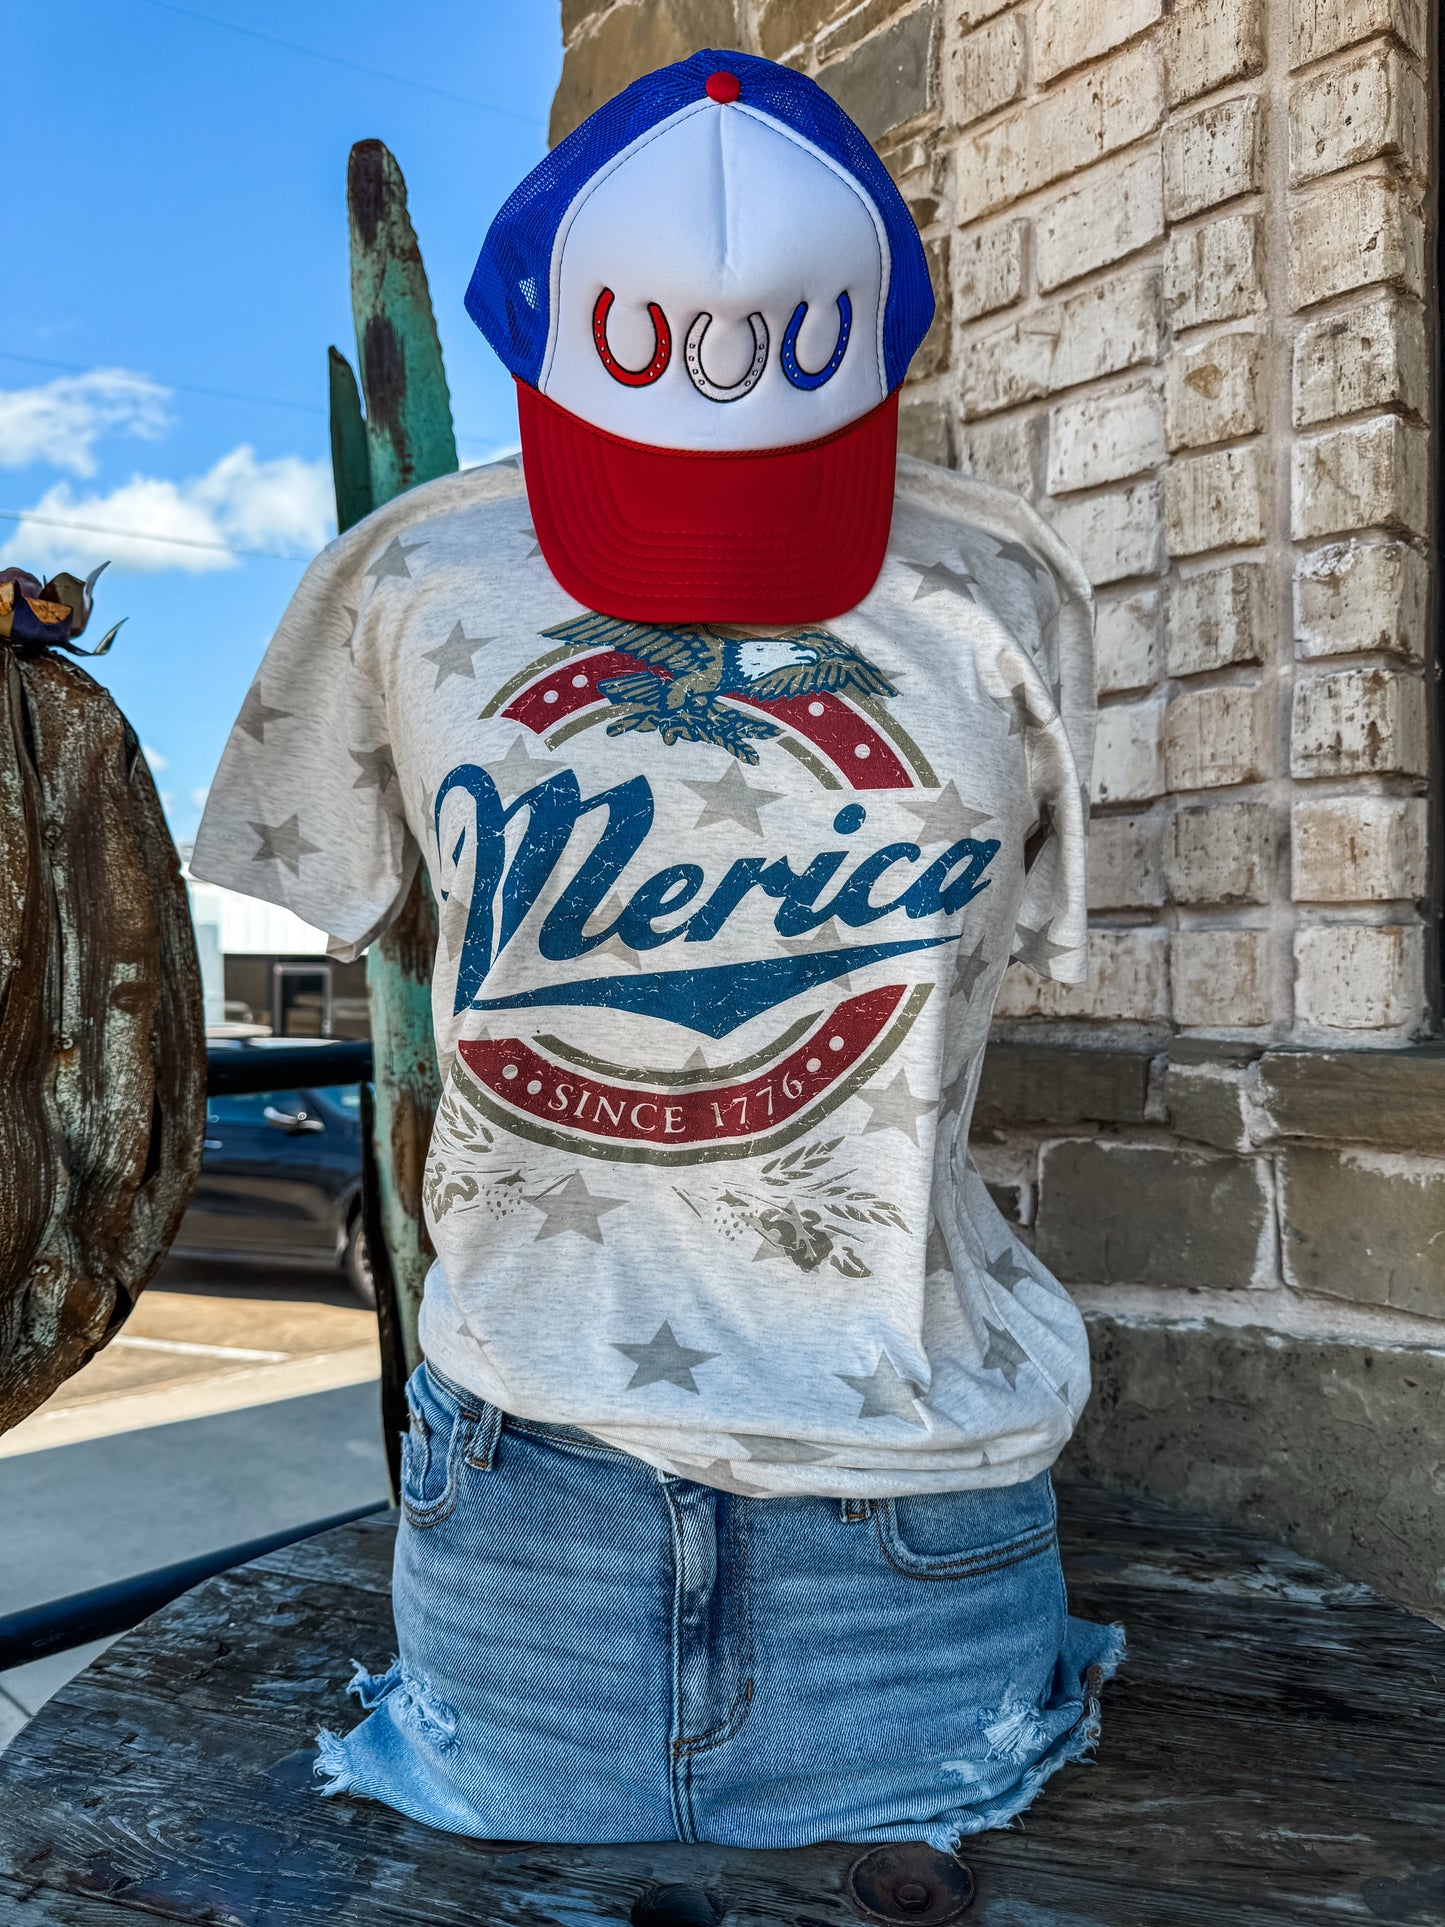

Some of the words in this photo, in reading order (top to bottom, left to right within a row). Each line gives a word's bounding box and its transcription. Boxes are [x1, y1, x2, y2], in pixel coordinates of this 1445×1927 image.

[435, 763, 1001, 1018] Merica
[547, 1083, 686, 1133] SINCE
[711, 1071, 803, 1127] 1776
